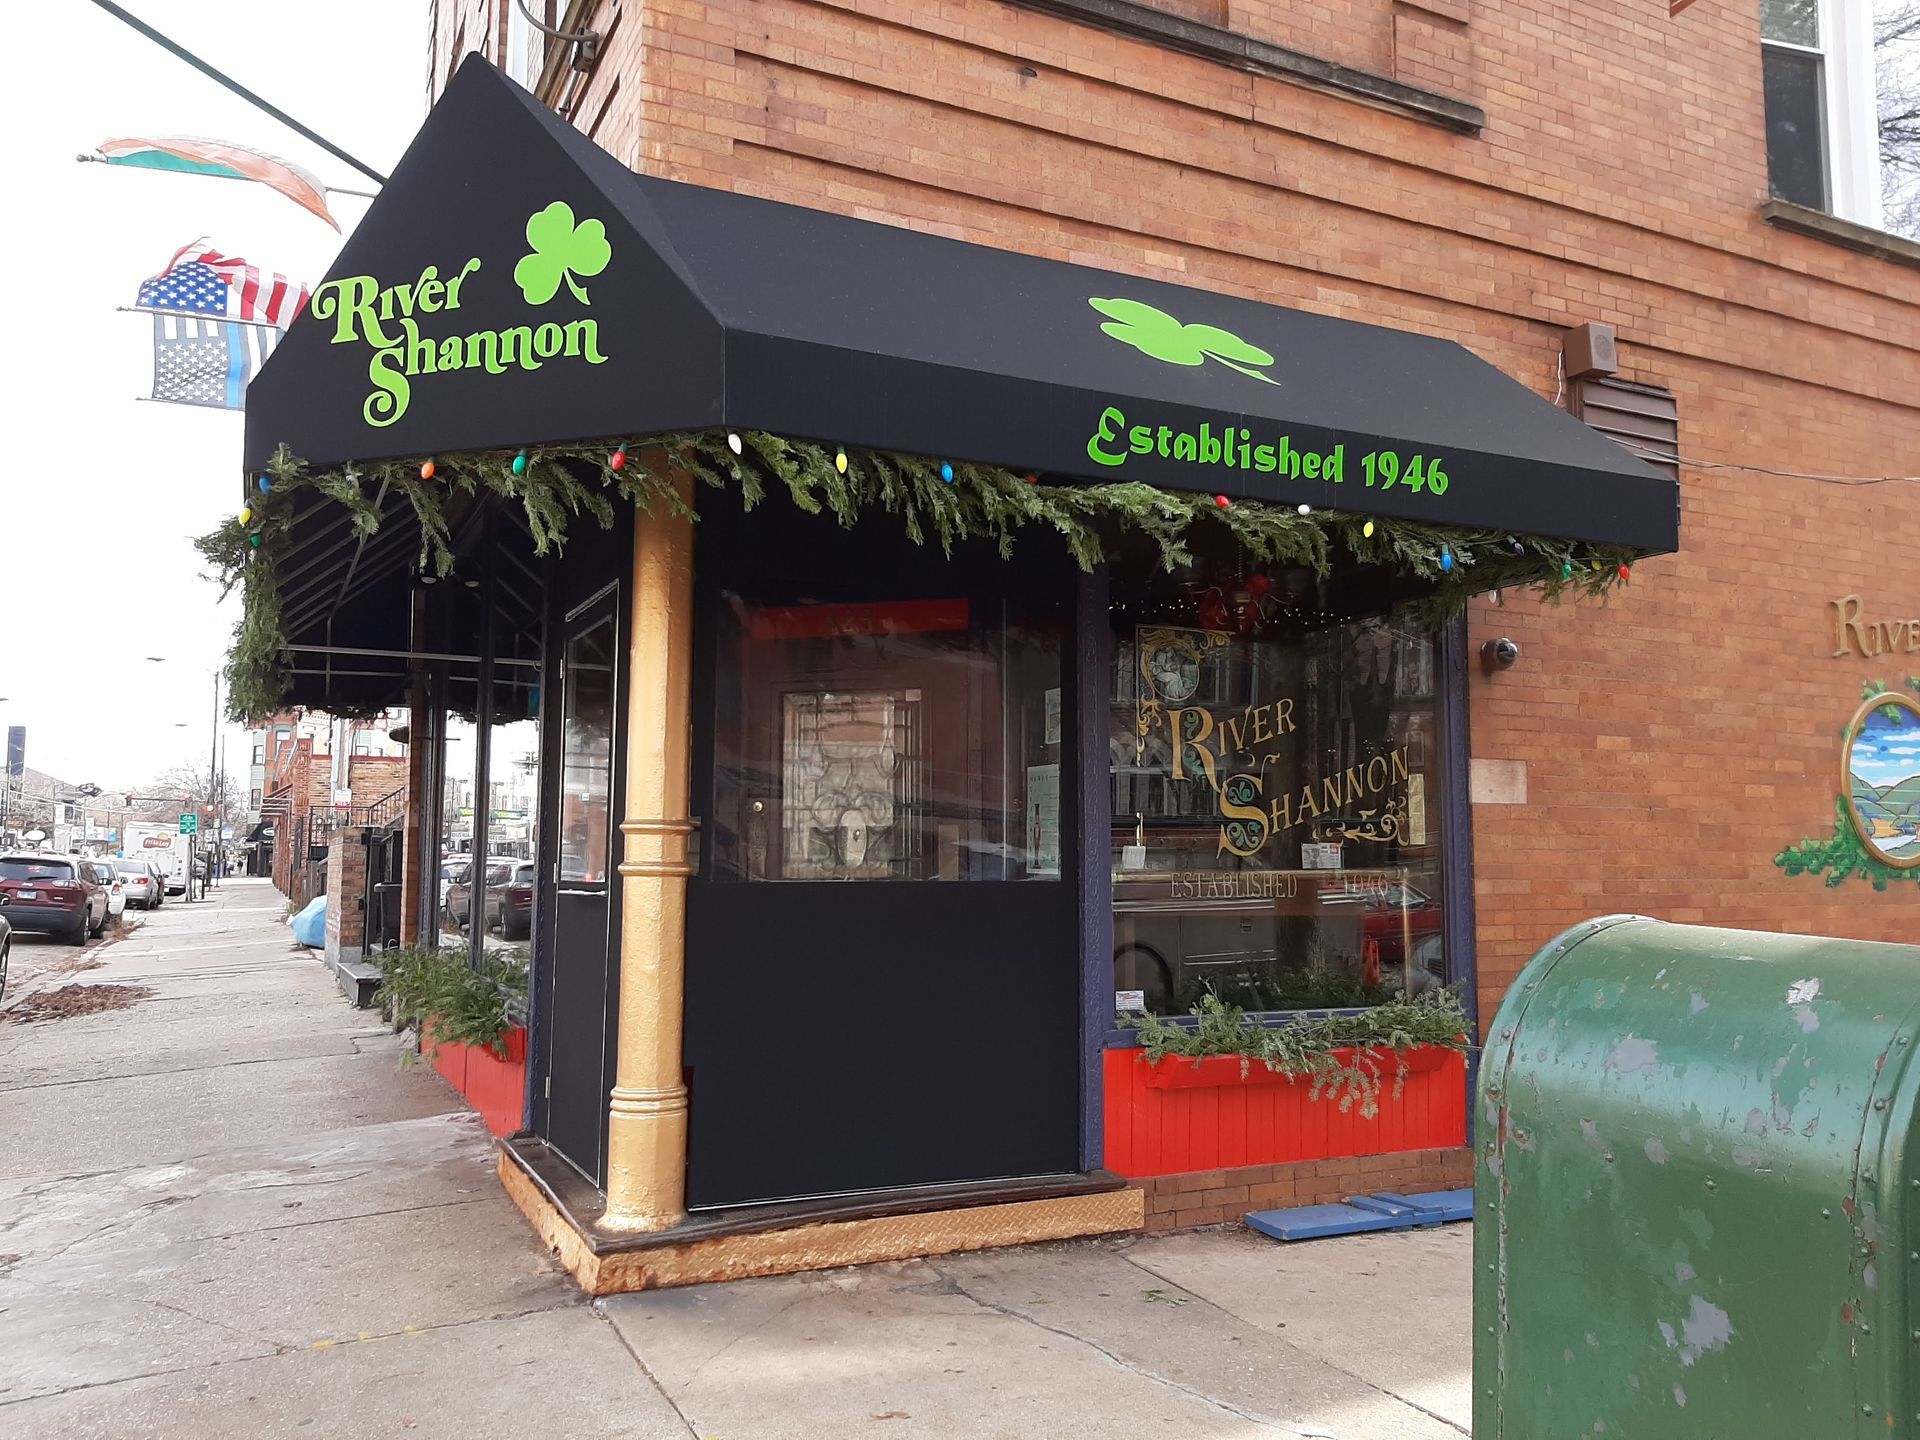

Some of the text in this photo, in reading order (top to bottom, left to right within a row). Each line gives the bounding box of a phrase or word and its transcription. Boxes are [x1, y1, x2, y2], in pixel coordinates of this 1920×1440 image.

[311, 257, 482, 349] River
[363, 317, 609, 428] Shannon
[1086, 405, 1450, 496] Established 1946
[1166, 698, 1296, 794] RIVER
[1216, 745, 1410, 859] SHANNON
[1169, 872, 1389, 899] ESTABLISHED 1946
